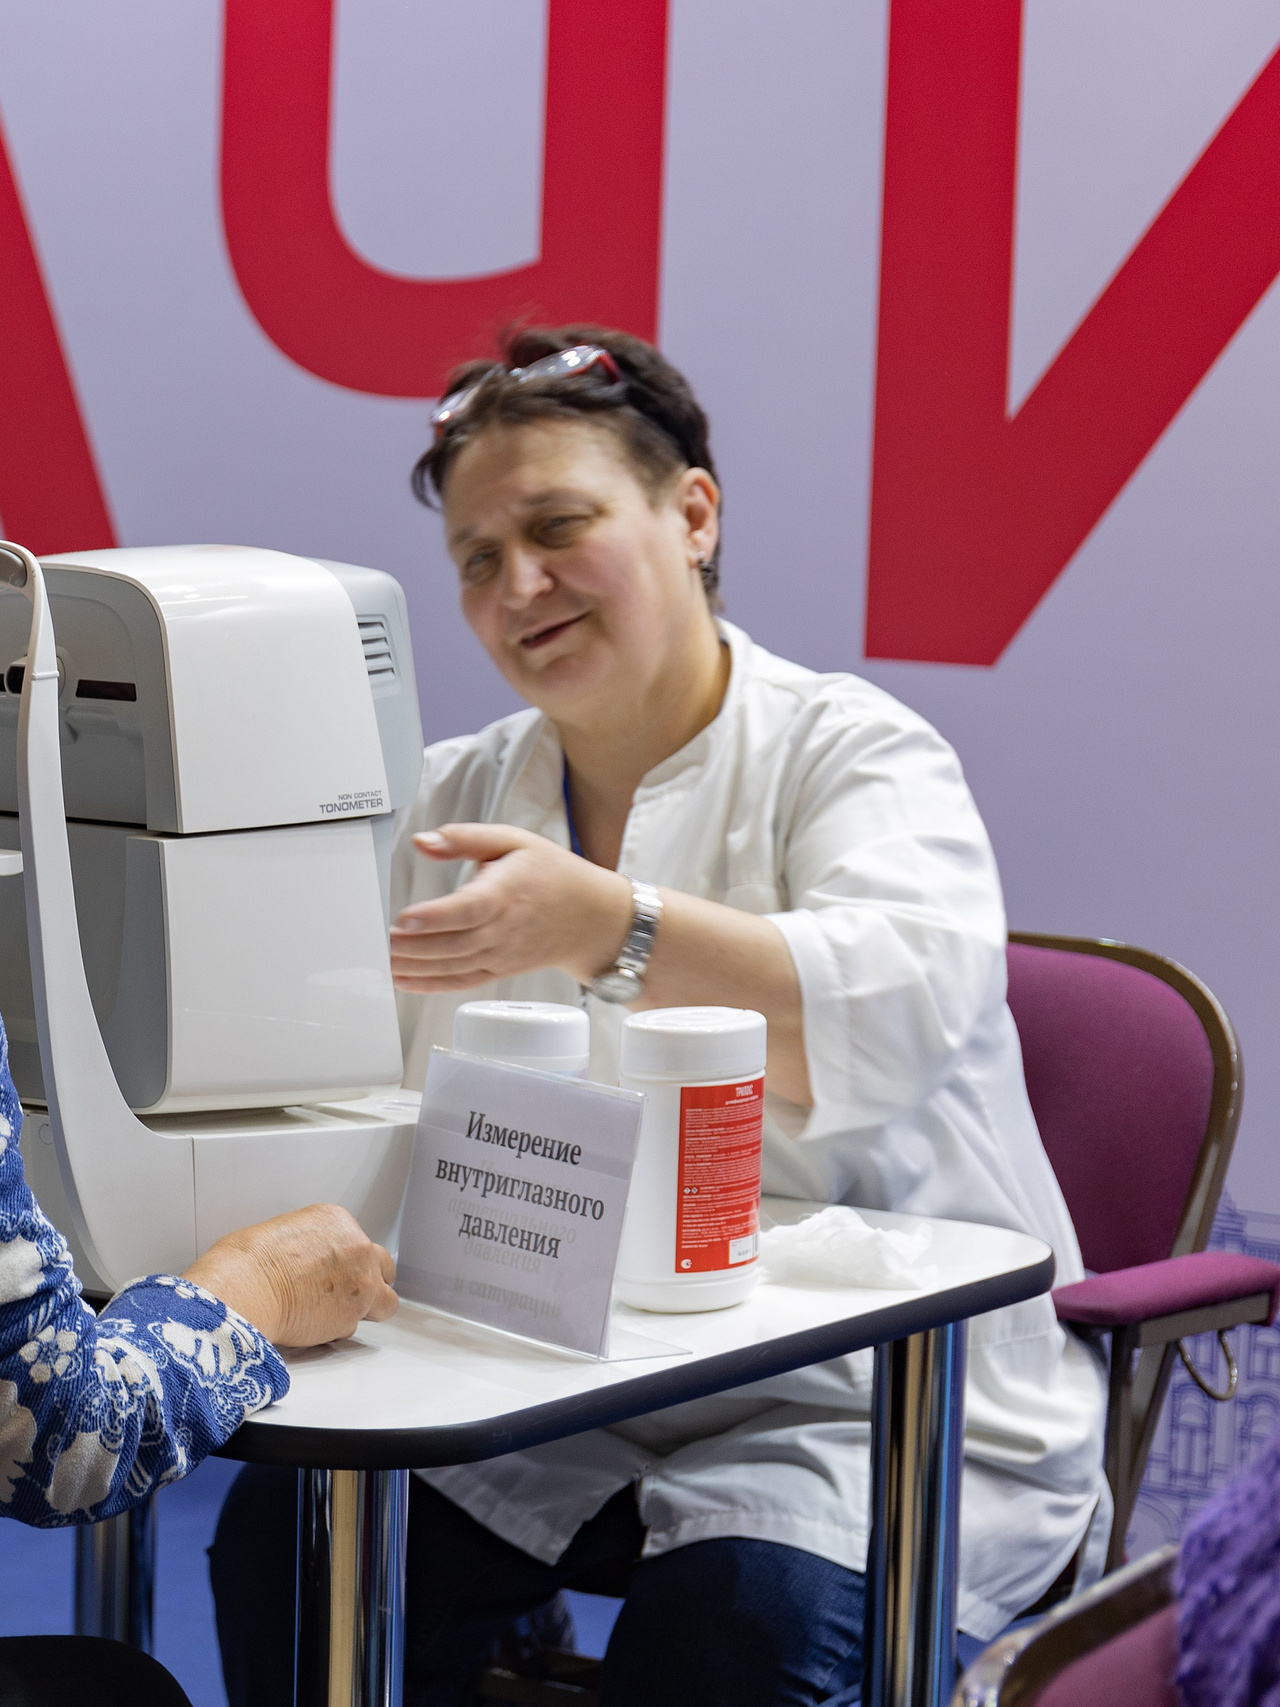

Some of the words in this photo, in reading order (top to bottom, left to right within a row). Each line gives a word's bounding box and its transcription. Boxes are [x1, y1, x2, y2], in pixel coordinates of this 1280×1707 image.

[320, 798, 383, 813] TONOMETER
[354, 790, 382, 799] CONTACT
[465, 1110, 582, 1166] Измерение
[435, 1158, 605, 1221] внутриглазного
[458, 1213, 562, 1259] давления
